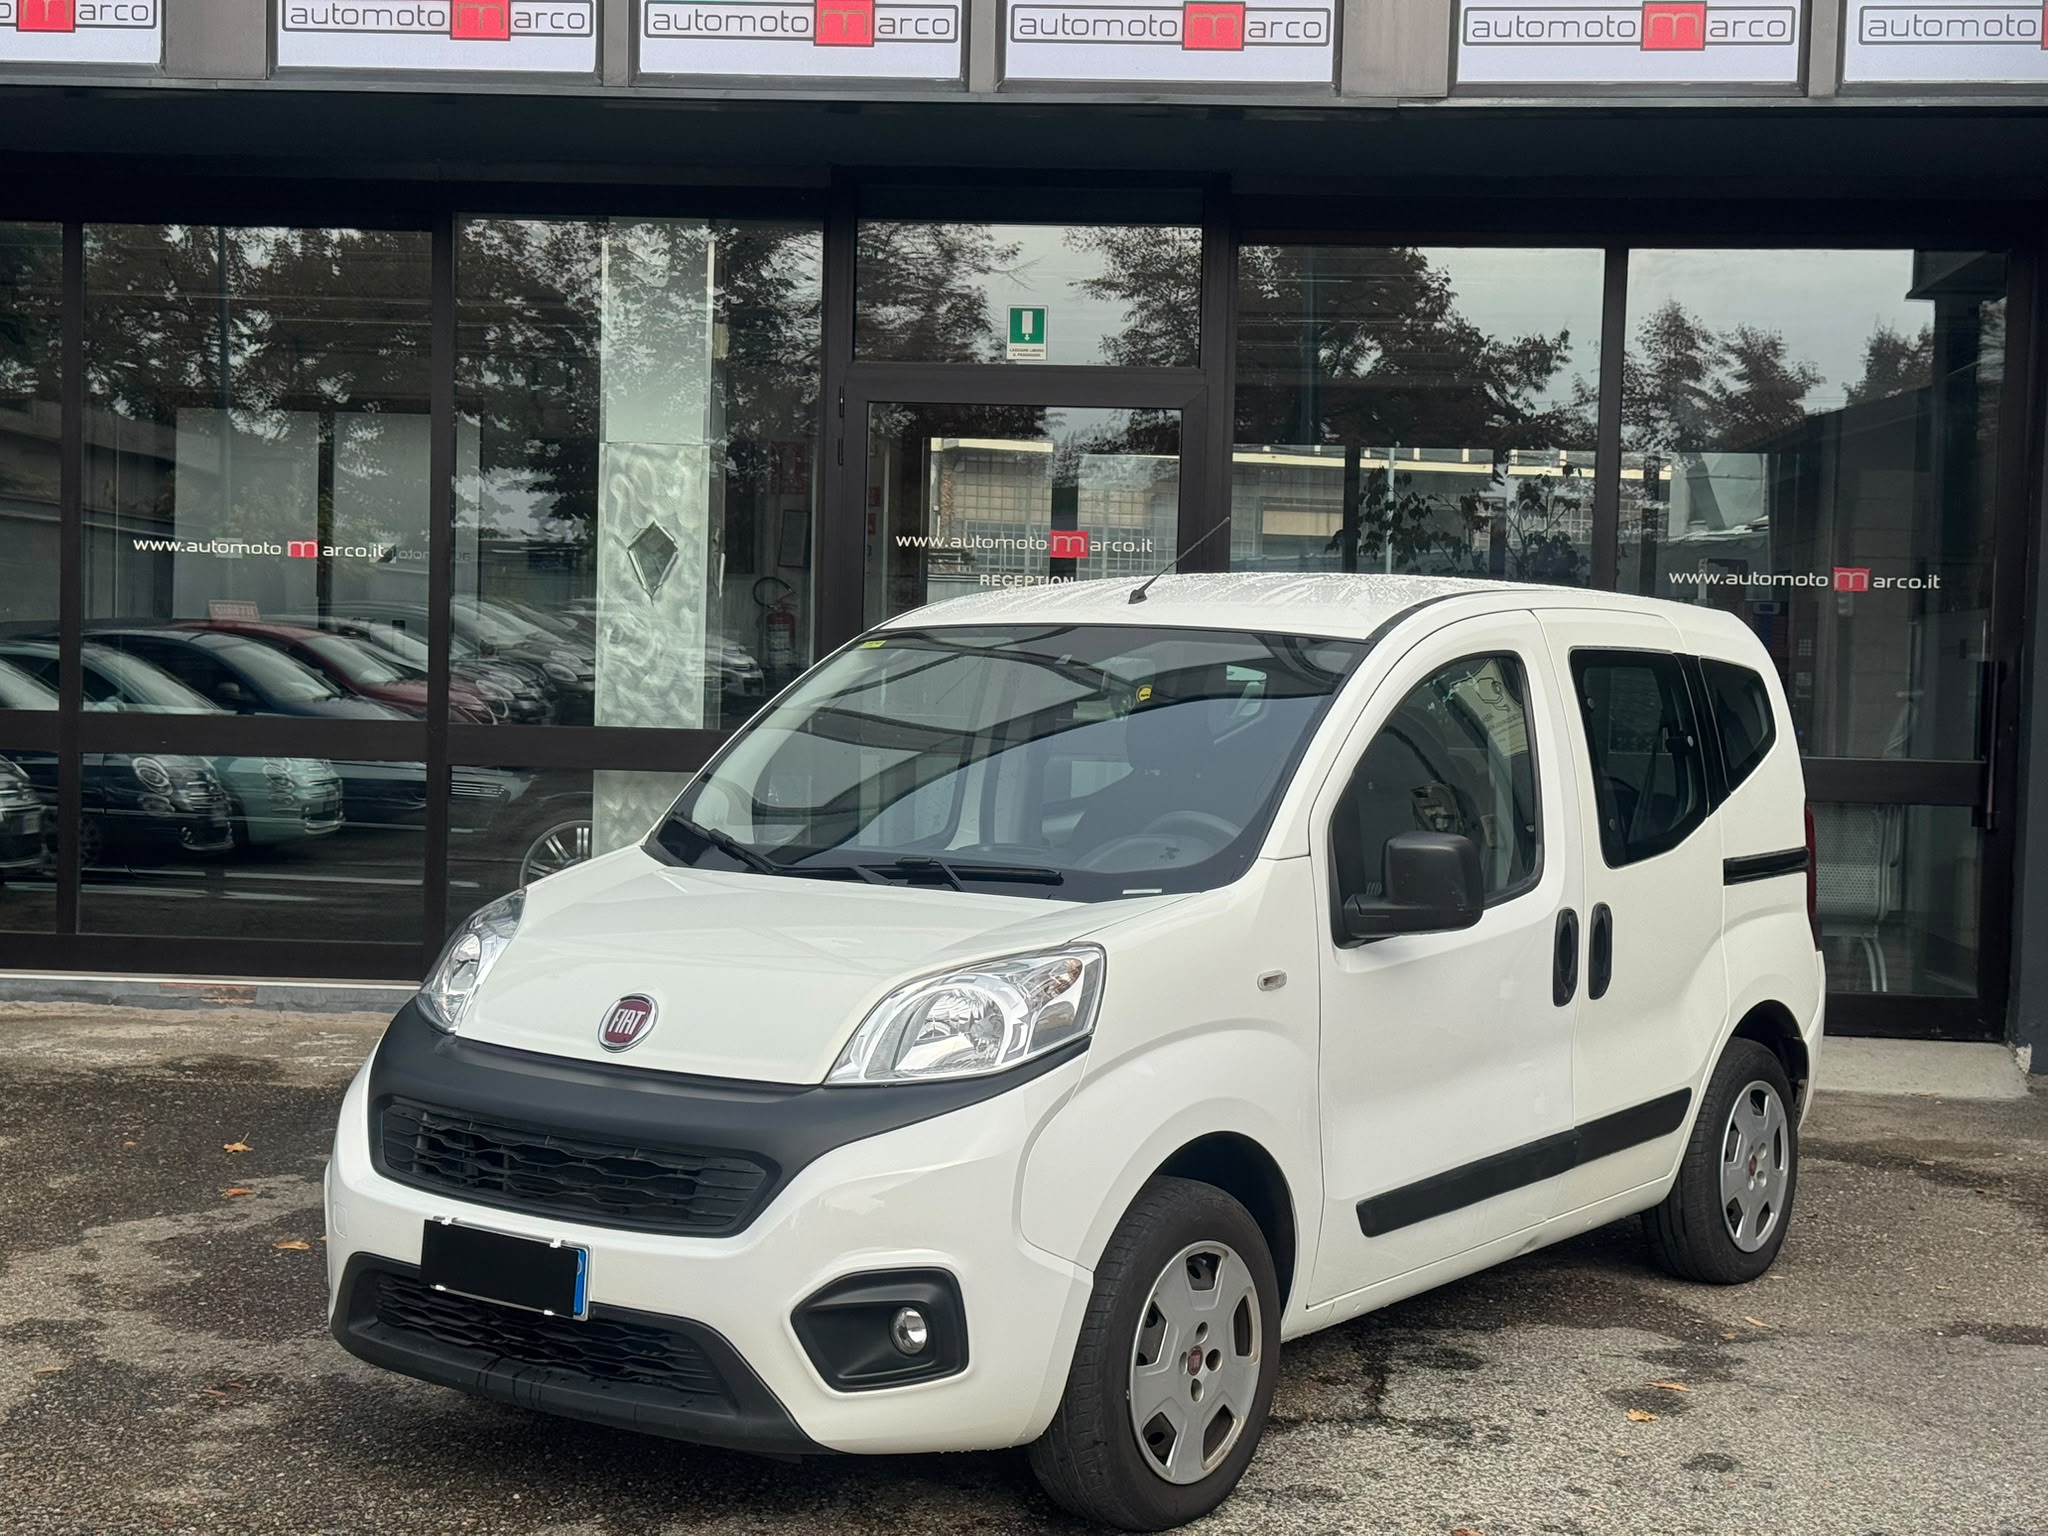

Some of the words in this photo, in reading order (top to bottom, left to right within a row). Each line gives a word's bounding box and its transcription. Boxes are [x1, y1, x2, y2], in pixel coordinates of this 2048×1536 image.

[290, 2, 445, 27] automoto
[652, 7, 809, 34] automoto
[1018, 12, 1178, 38] automoto
[1471, 14, 1636, 39] automoto
[1868, 13, 2037, 37] automoto
[980, 574, 1074, 587] RECEPTION
[608, 1008, 647, 1035] FIAT
